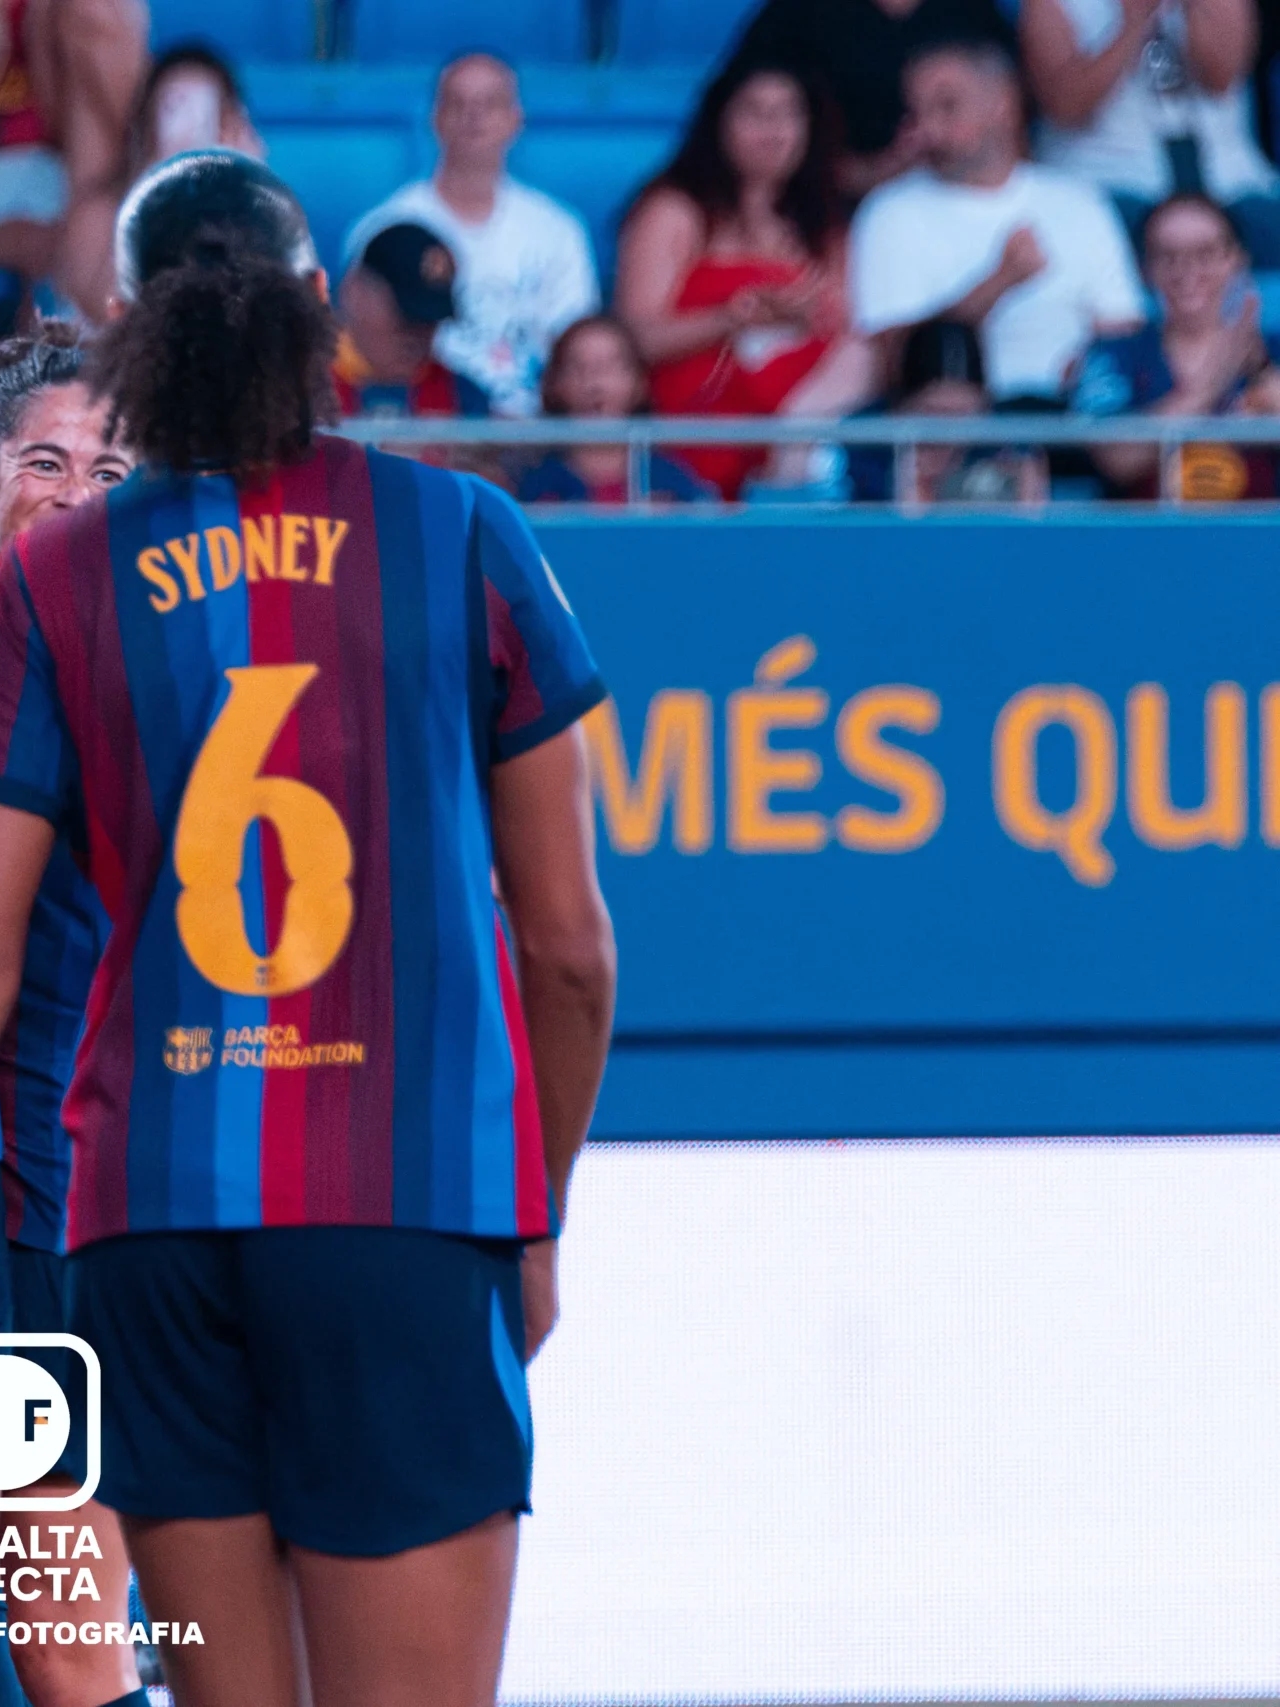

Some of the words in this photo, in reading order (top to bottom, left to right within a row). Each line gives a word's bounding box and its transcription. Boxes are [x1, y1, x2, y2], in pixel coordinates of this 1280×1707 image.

[136, 513, 349, 613] SYDNEY
[582, 632, 947, 856] MÉS
[173, 663, 355, 997] 6
[221, 1041, 366, 1068] FOUNDATION
[223, 1023, 301, 1047] BARÇA
